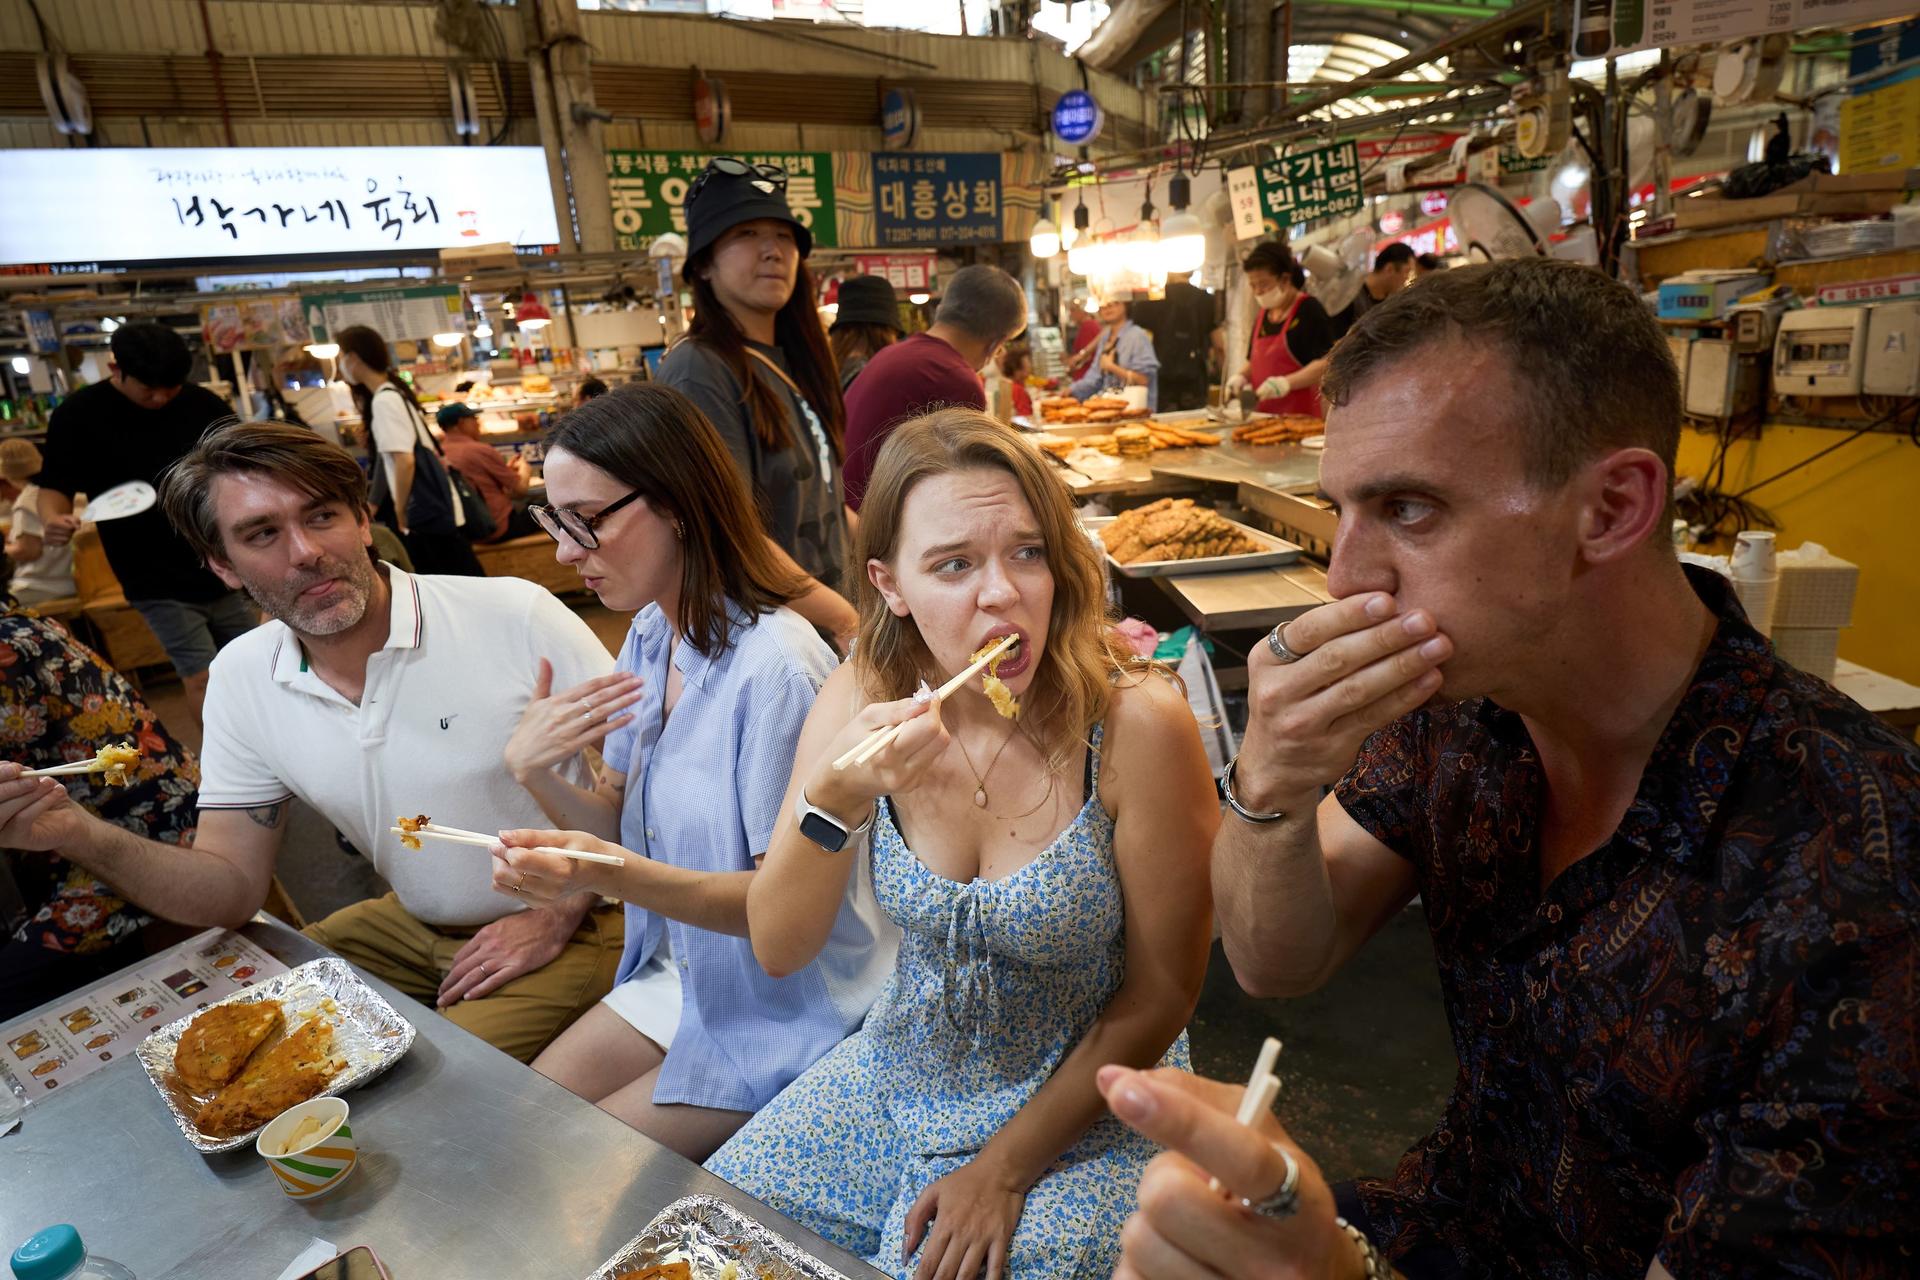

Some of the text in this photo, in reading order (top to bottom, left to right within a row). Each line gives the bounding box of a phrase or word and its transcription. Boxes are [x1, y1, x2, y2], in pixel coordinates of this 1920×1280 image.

[172, 175, 439, 240] 박가네 육회
[881, 179, 997, 219] 대흥상회
